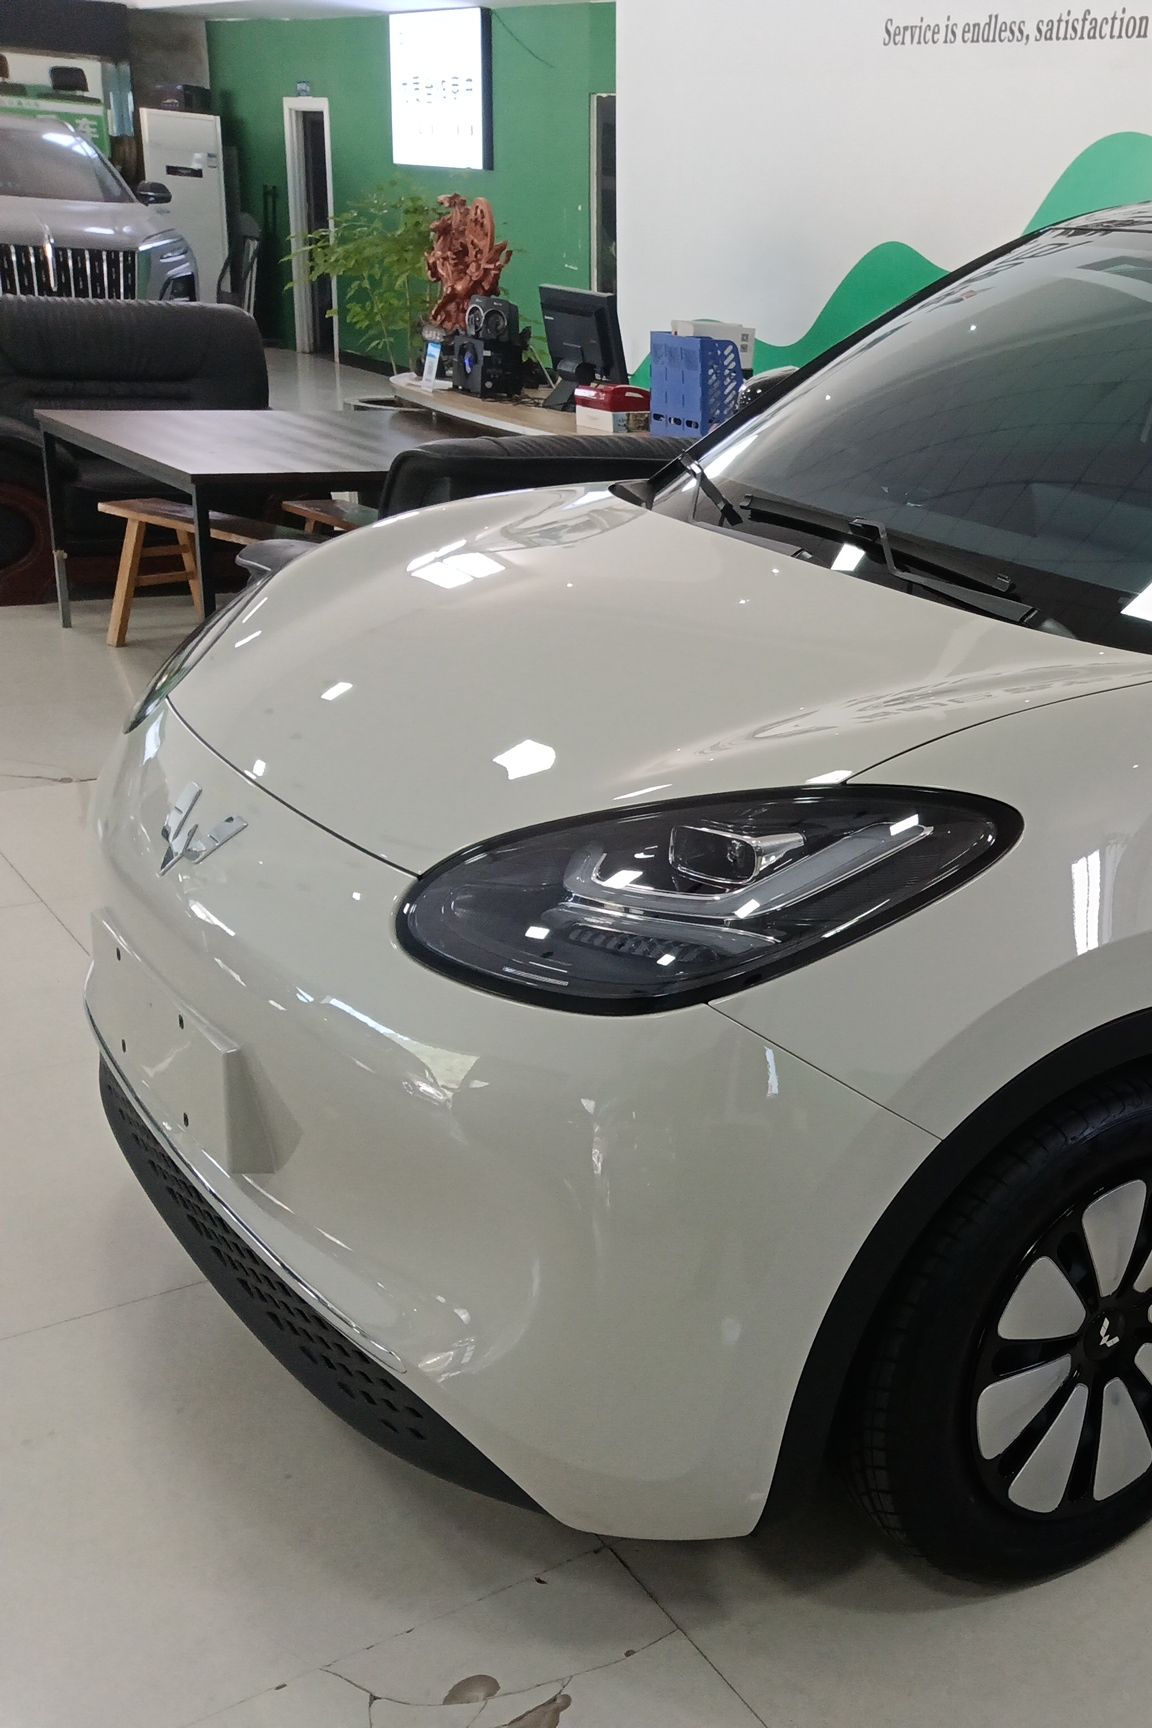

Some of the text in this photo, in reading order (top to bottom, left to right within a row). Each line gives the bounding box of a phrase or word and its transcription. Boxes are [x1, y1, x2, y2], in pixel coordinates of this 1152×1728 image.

[883, 16, 941, 46] Service
[943, 15, 958, 44] is
[961, 13, 1030, 46] endless,
[1034, 8, 1150, 42] satisfaction
